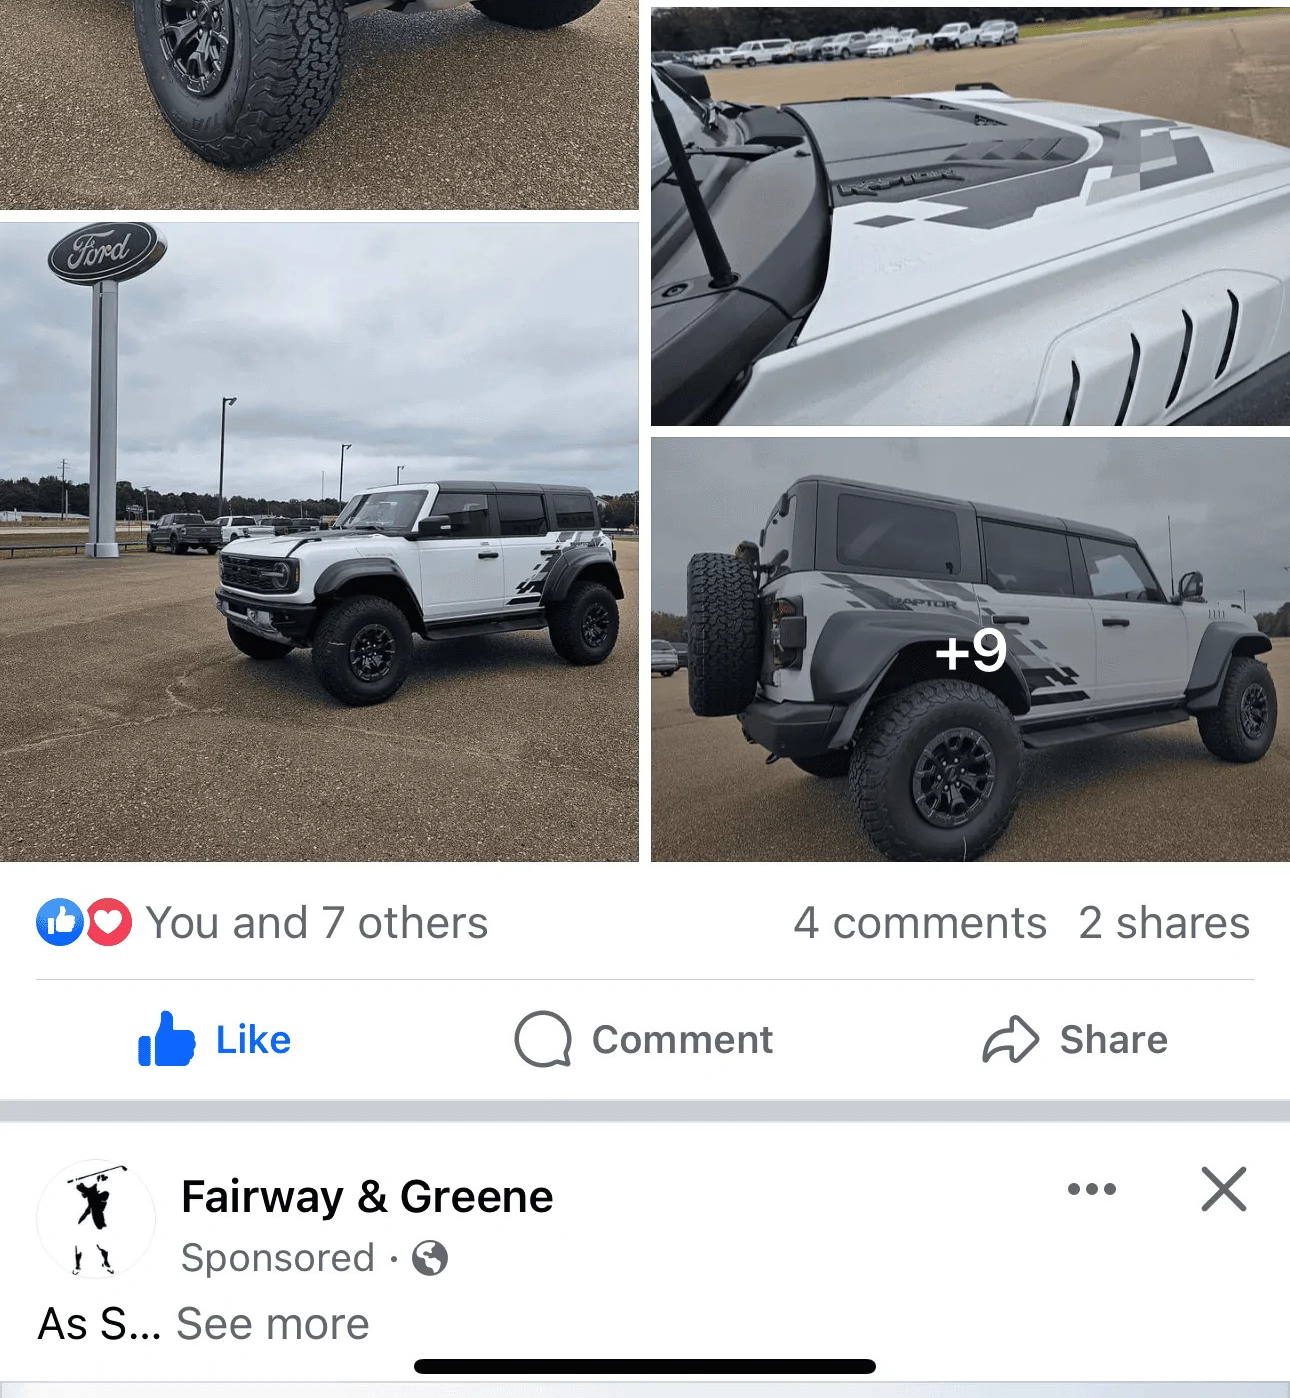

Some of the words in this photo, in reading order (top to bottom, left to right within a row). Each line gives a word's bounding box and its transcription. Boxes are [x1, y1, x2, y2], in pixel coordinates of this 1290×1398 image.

[67, 229, 132, 270] Ford
[146, 906, 217, 939] You
[234, 905, 306, 939] and
[323, 906, 344, 938] 7
[359, 905, 487, 939] others
[794, 906, 819, 938] 4
[834, 908, 1046, 939] comments
[1080, 905, 1101, 938] 2
[1117, 905, 1249, 939] shares
[218, 1023, 290, 1054] Like
[593, 1025, 773, 1054] Comment
[1061, 1024, 1167, 1054] Share
[184, 1177, 344, 1221] Fairway
[358, 1179, 388, 1213] &
[401, 1179, 553, 1213] Greene
[182, 1242, 373, 1278] Sponsored
[37, 1307, 86, 1340] As
[101, 1306, 160, 1340] S...
[177, 1306, 252, 1340] See
[268, 1315, 369, 1340] more
